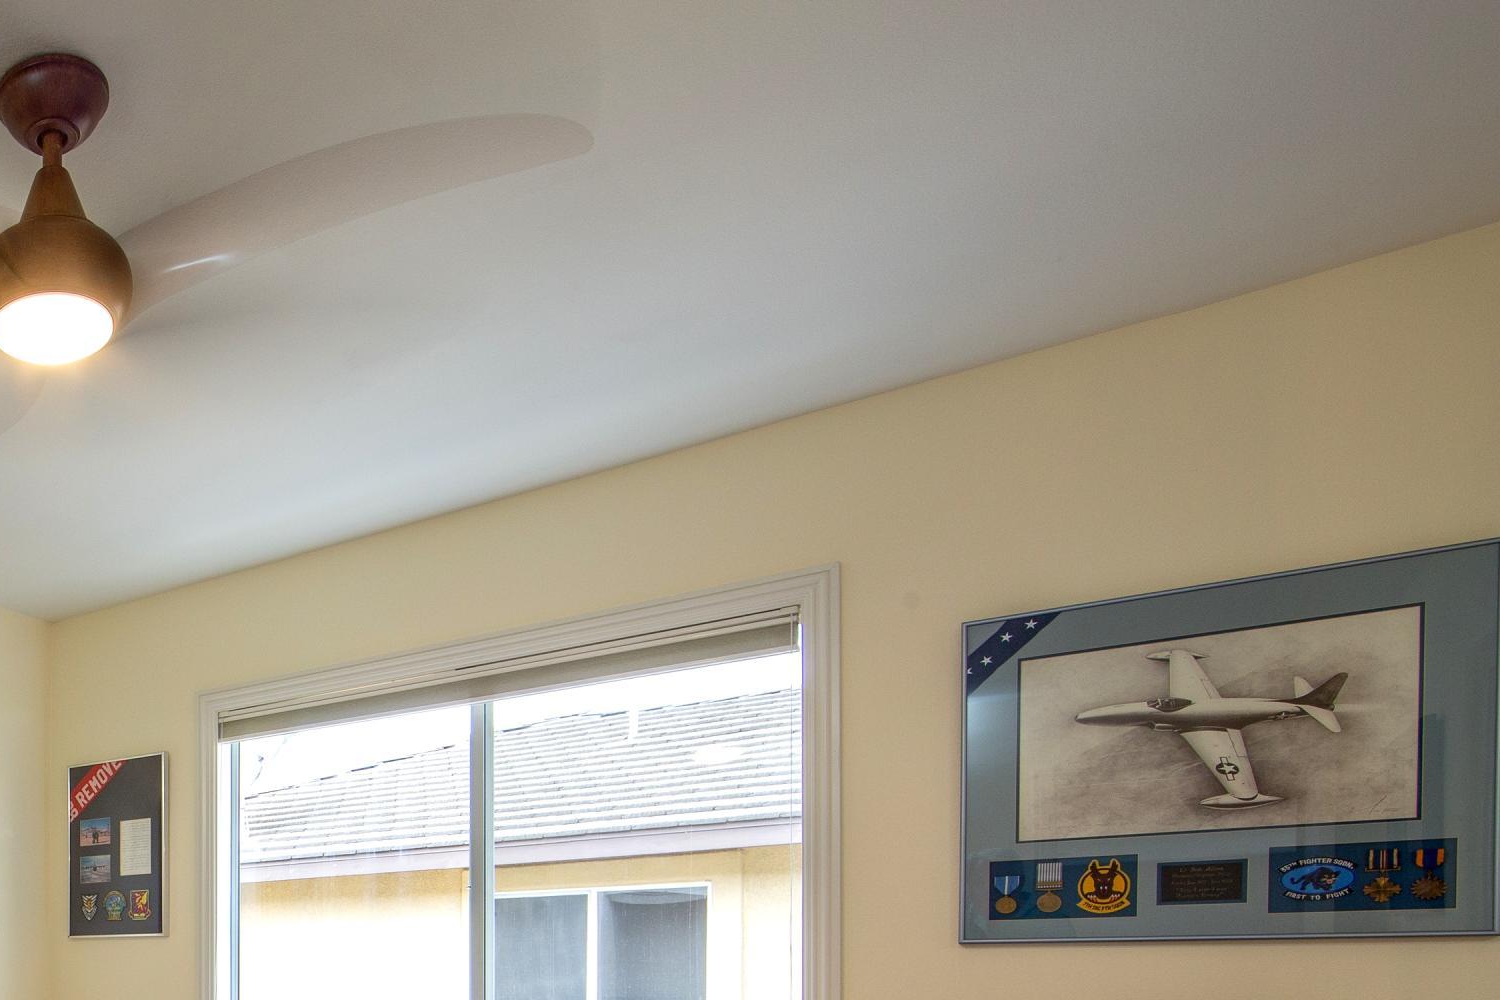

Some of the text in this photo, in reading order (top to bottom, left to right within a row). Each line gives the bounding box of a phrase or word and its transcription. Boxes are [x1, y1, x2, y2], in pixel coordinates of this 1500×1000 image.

[1299, 857, 1332, 866] FIGHTER
[1285, 891, 1306, 899] FIRST
[1326, 888, 1349, 899] FIGHT
